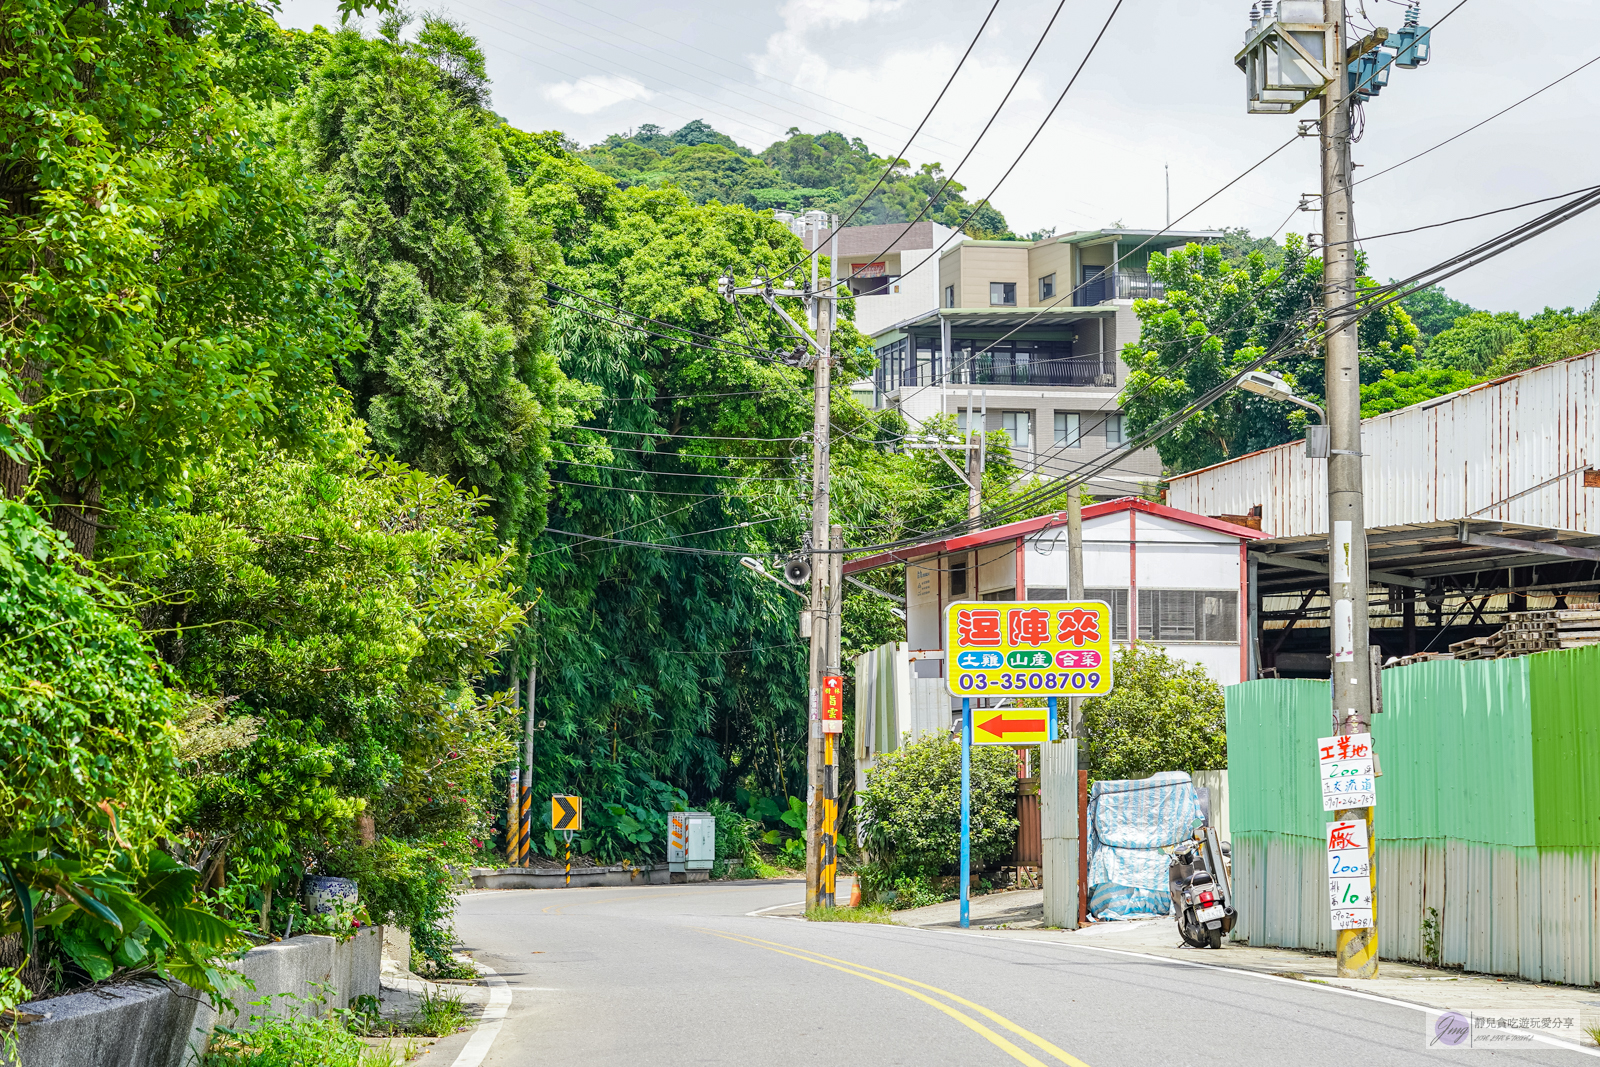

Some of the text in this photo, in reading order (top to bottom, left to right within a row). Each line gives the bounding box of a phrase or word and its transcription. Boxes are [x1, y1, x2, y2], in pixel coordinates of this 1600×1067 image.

[958, 608, 1101, 647] 逗陣來
[961, 653, 1001, 667] 土雞
[1059, 652, 1098, 667] 合菜
[960, 673, 1100, 690] 03-3508709
[1320, 735, 1368, 760] 工業地
[1342, 883, 1359, 904] 10
